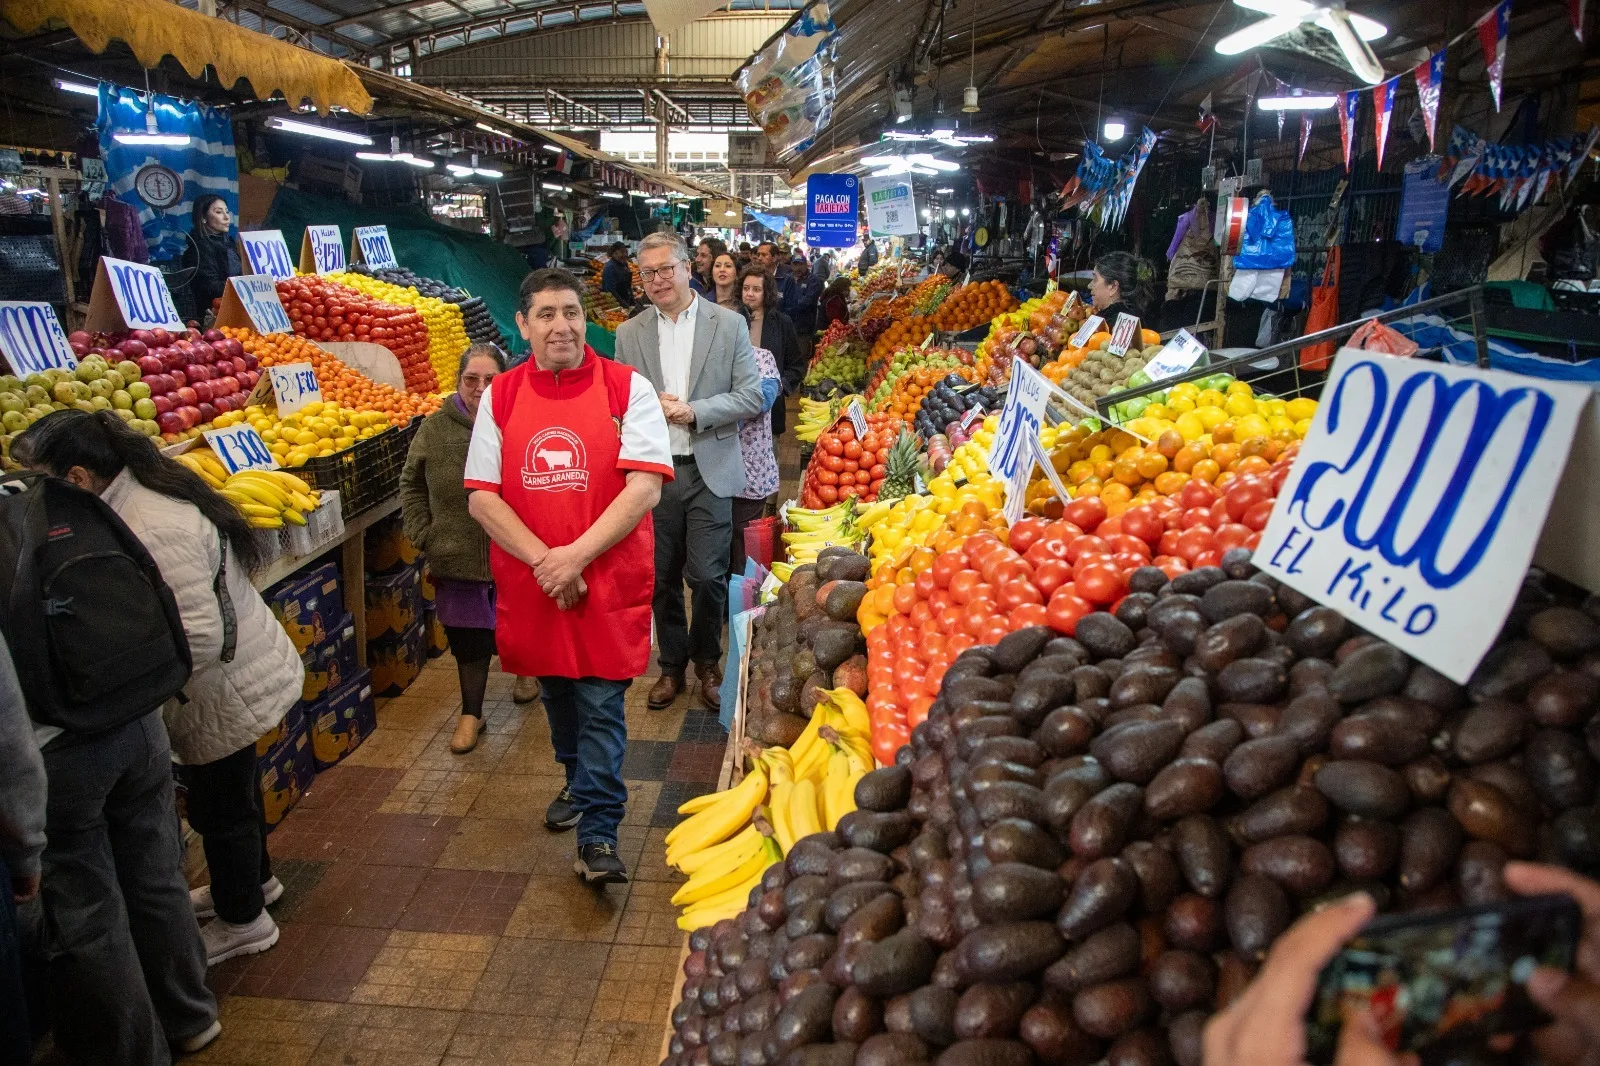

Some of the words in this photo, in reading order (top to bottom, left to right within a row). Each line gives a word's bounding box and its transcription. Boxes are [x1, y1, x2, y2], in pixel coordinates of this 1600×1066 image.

[815, 194, 834, 203] PAGA
[836, 194, 850, 204] CON
[816, 204, 849, 213] TARJETAS
[874, 187, 905, 201] TARJETAS
[245, 240, 291, 278] 1200
[44, 305, 56, 320] EL
[112, 265, 168, 325] 1000
[0, 305, 63, 375] 1000
[215, 429, 273, 475] 1300
[523, 475, 551, 486] CARNES
[551, 471, 586, 483] ARANEDA
[1287, 361, 1555, 590] 2000
[1269, 525, 1314, 576] EL
